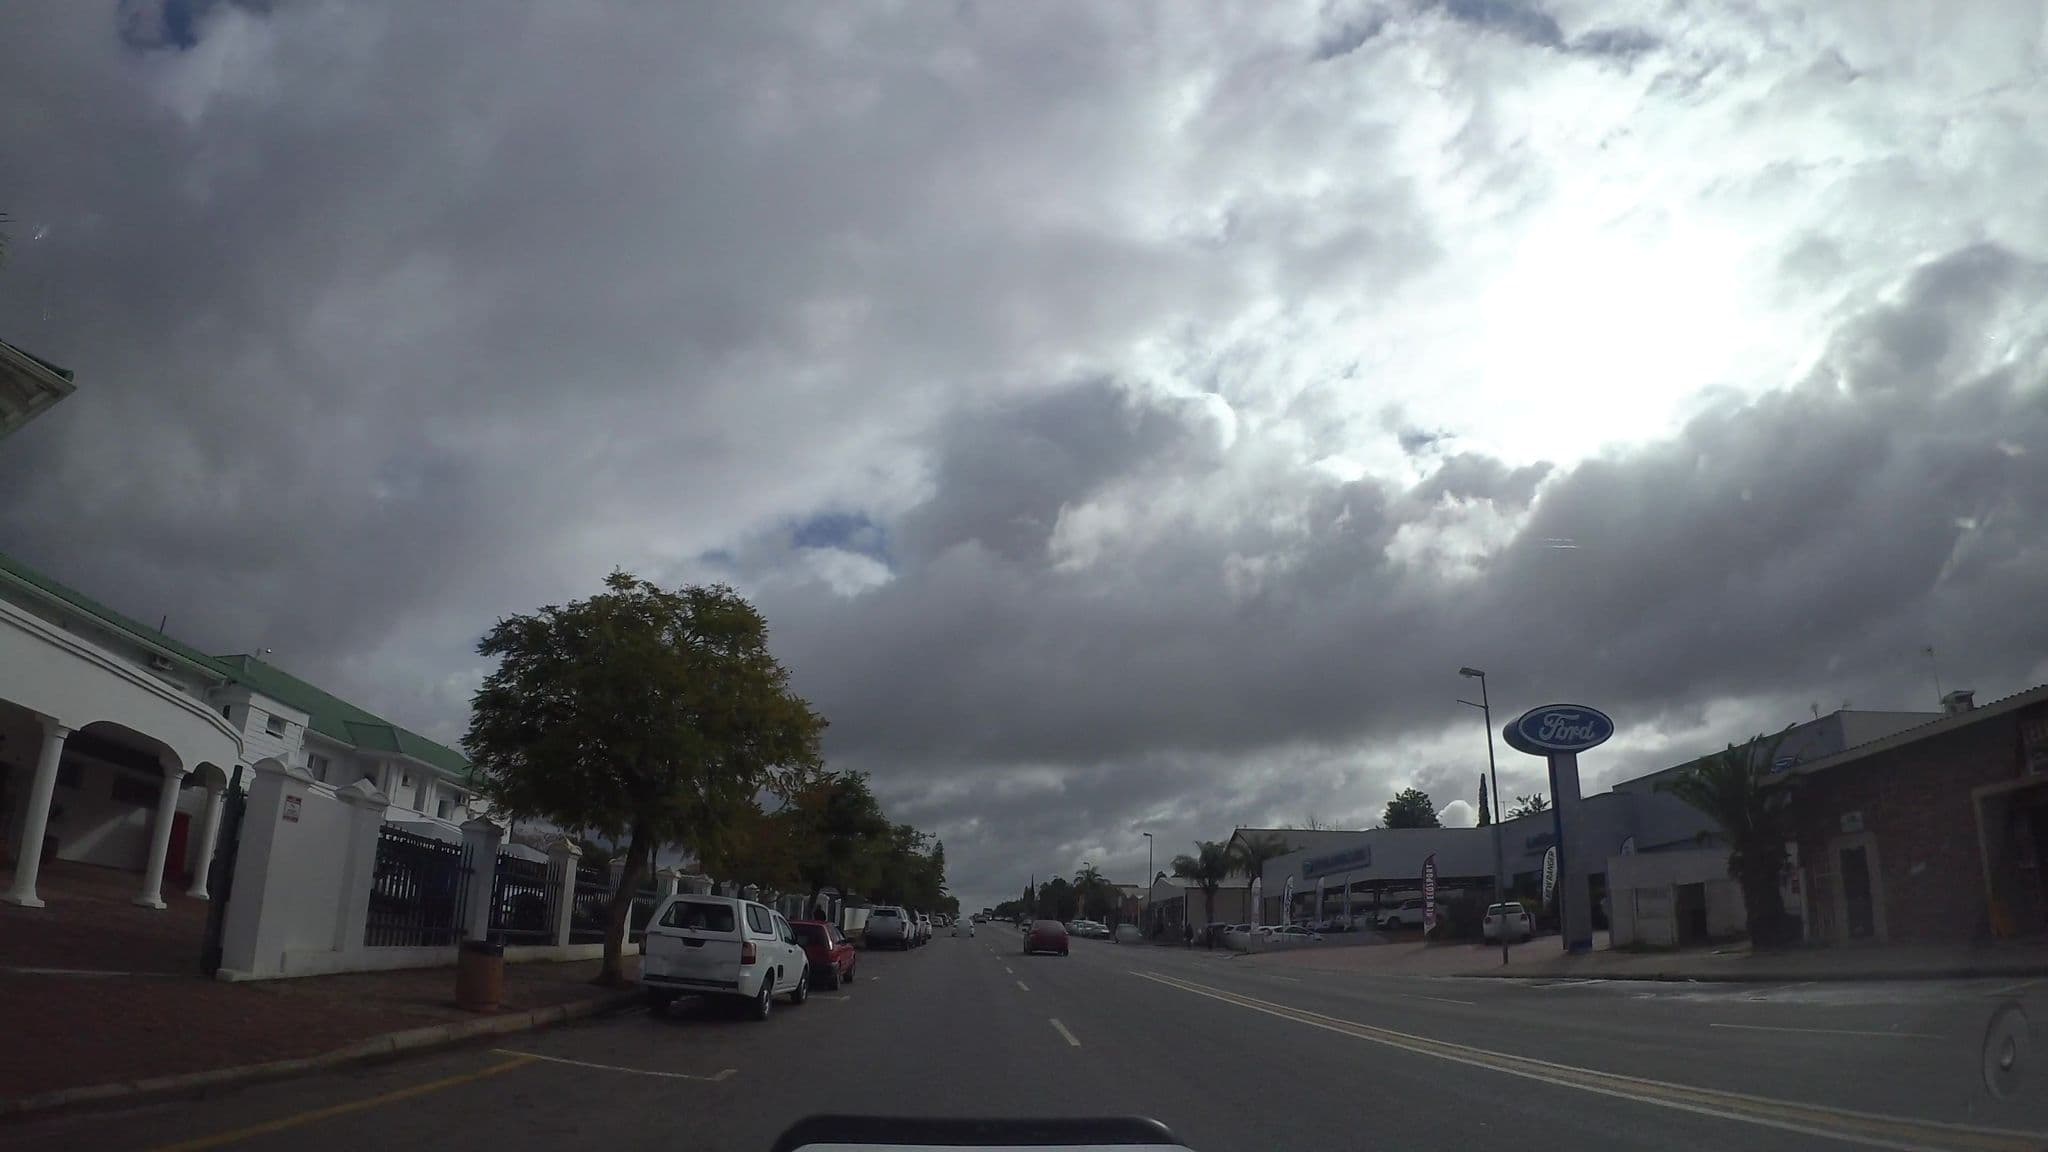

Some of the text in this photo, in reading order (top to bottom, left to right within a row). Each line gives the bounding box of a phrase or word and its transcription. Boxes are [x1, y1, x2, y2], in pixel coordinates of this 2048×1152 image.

[1538, 712, 1595, 741] Ford
[1425, 863, 1434, 900] ECOSPORT
[1546, 851, 1555, 882] RANGER
